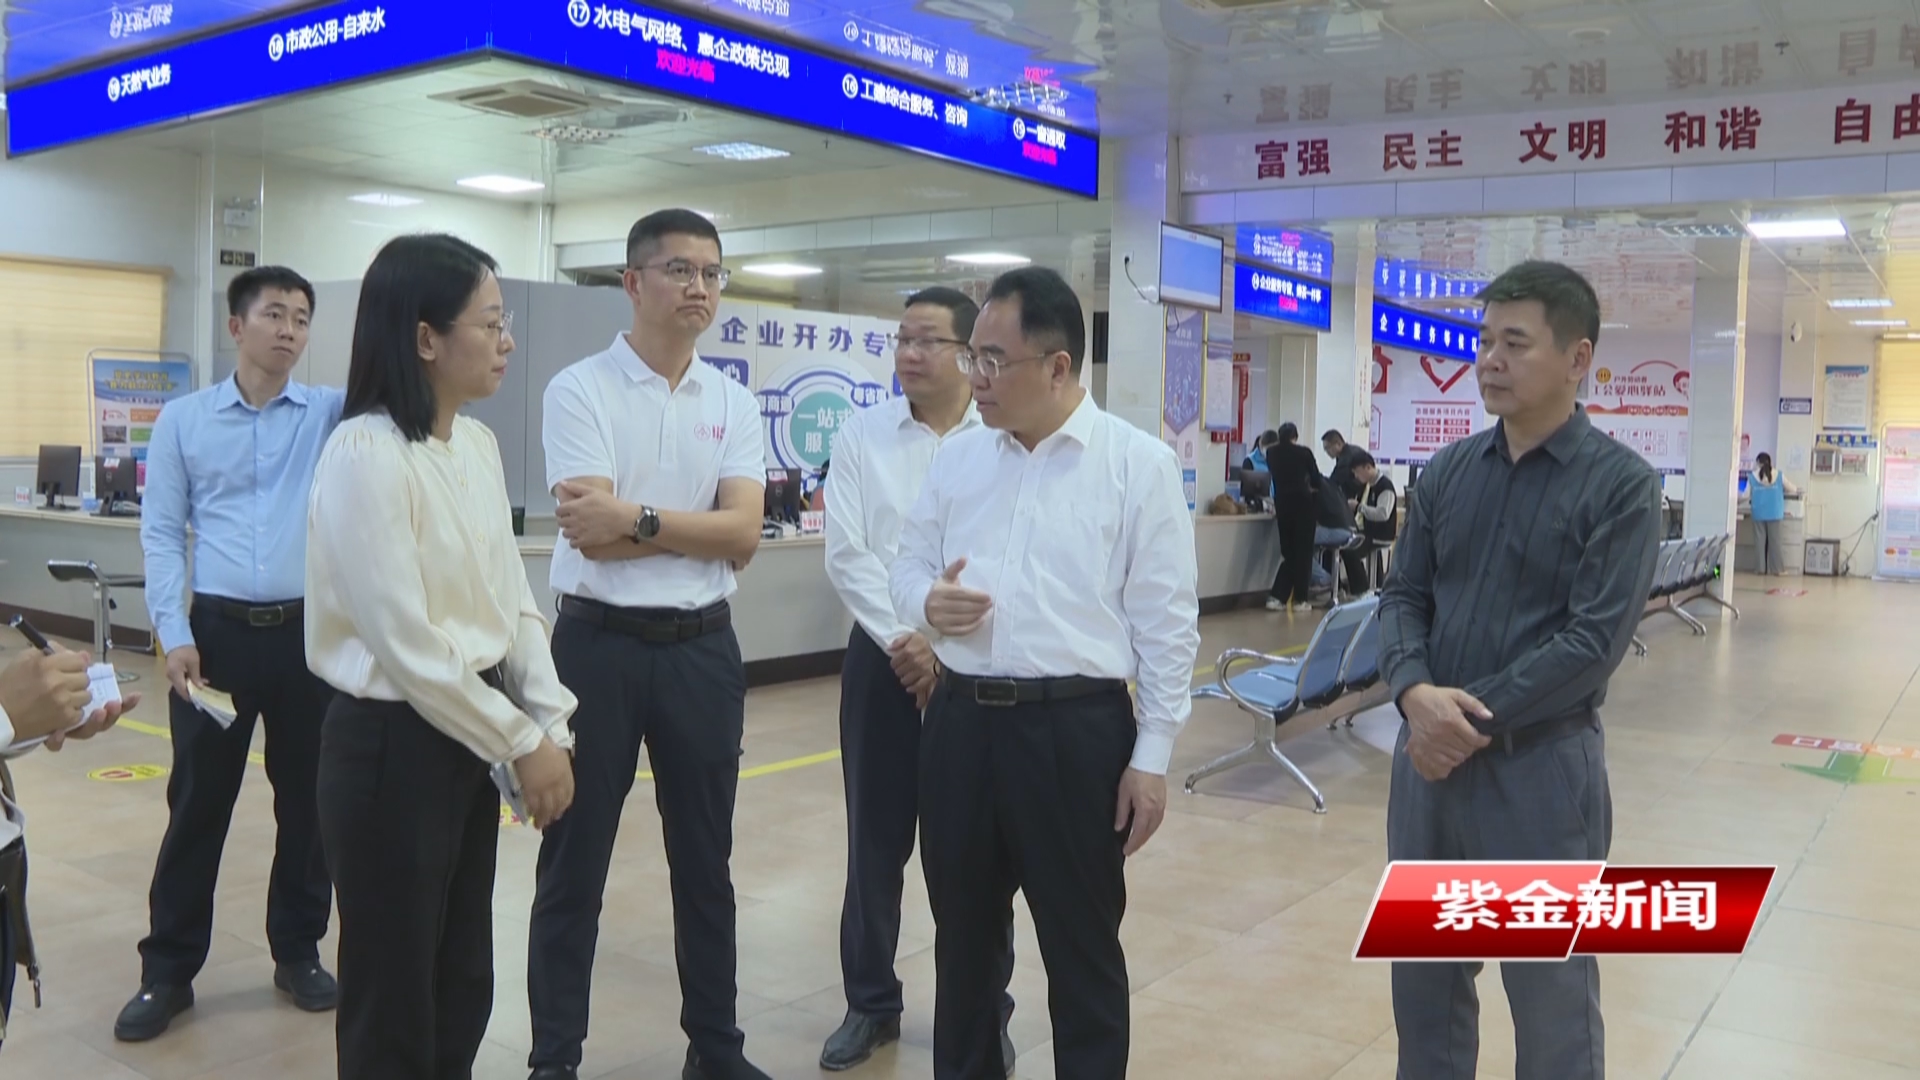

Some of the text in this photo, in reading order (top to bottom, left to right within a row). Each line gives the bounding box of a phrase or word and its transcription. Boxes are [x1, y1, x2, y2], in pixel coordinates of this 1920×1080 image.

[286, 5, 386, 54] 市政公用-自来水
[121, 63, 171, 97] 天然气业务
[1255, 139, 1331, 180] 富强
[1382, 129, 1463, 172] 民主
[1519, 121, 1606, 161] 文明
[1664, 106, 1761, 154] 和谐
